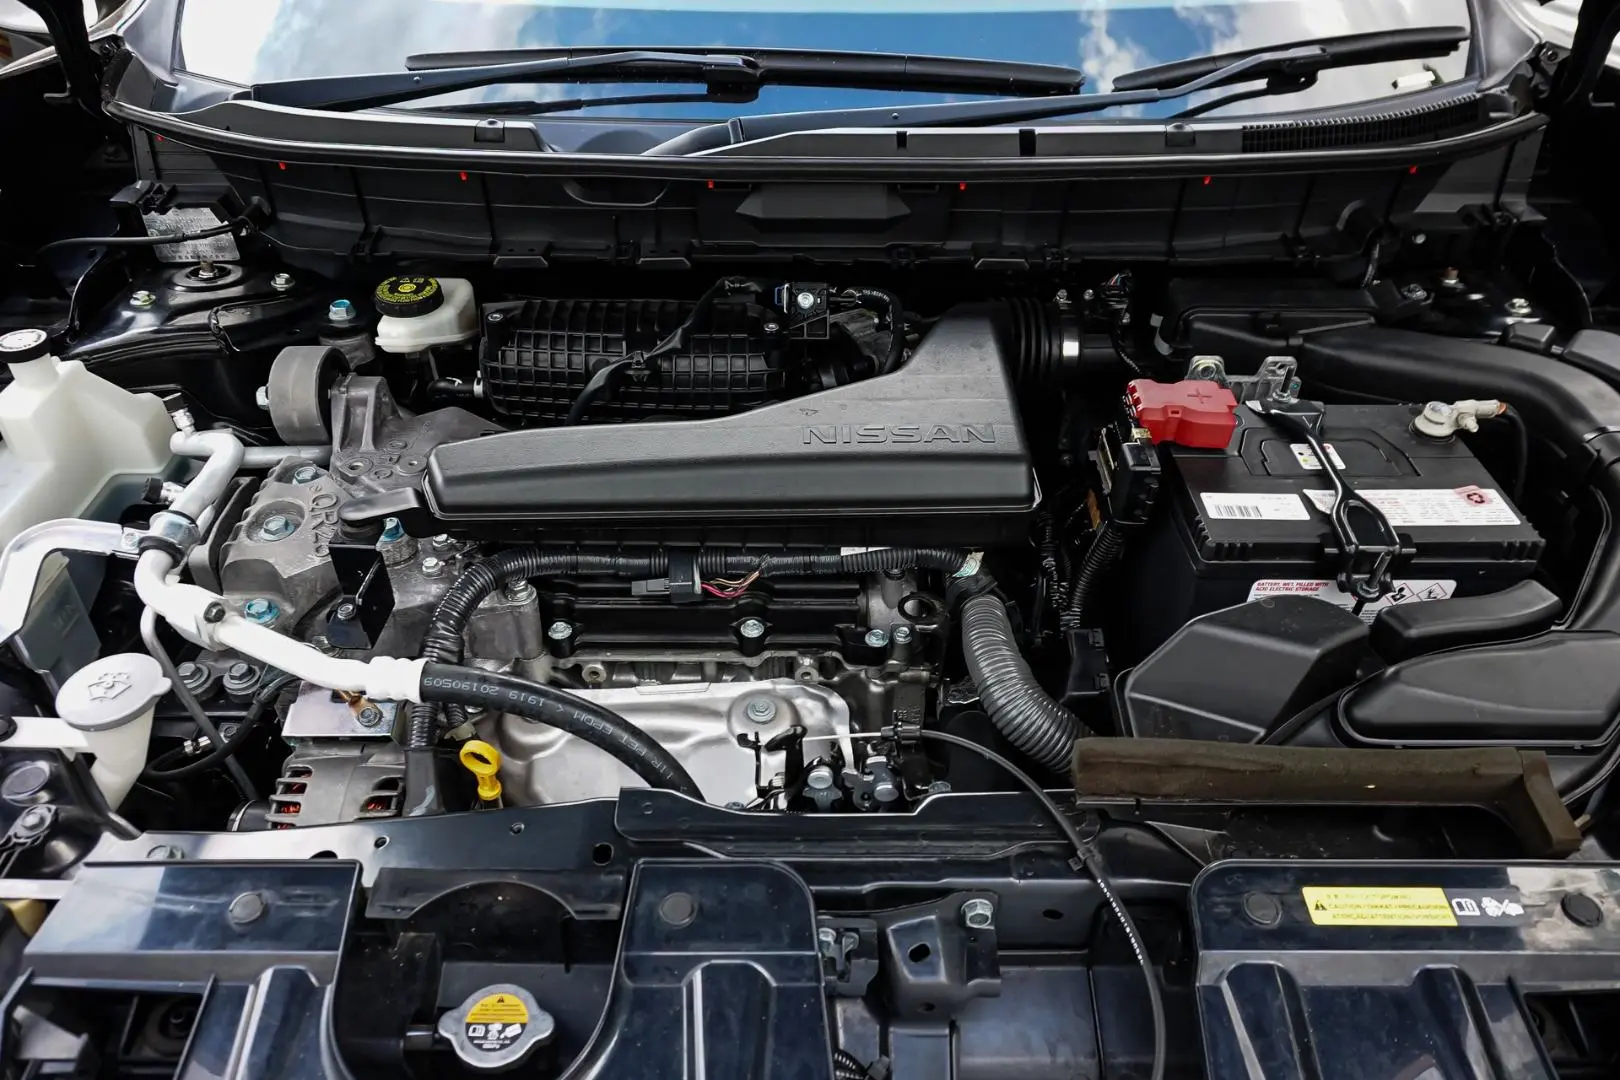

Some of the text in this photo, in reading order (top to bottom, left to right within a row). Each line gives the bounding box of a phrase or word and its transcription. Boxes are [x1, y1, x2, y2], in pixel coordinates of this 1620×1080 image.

[802, 424, 996, 444] NISSAN
[423, 676, 500, 696] 20190509
[508, 690, 545, 707] 1919
[572, 710, 614, 736] EPDM
